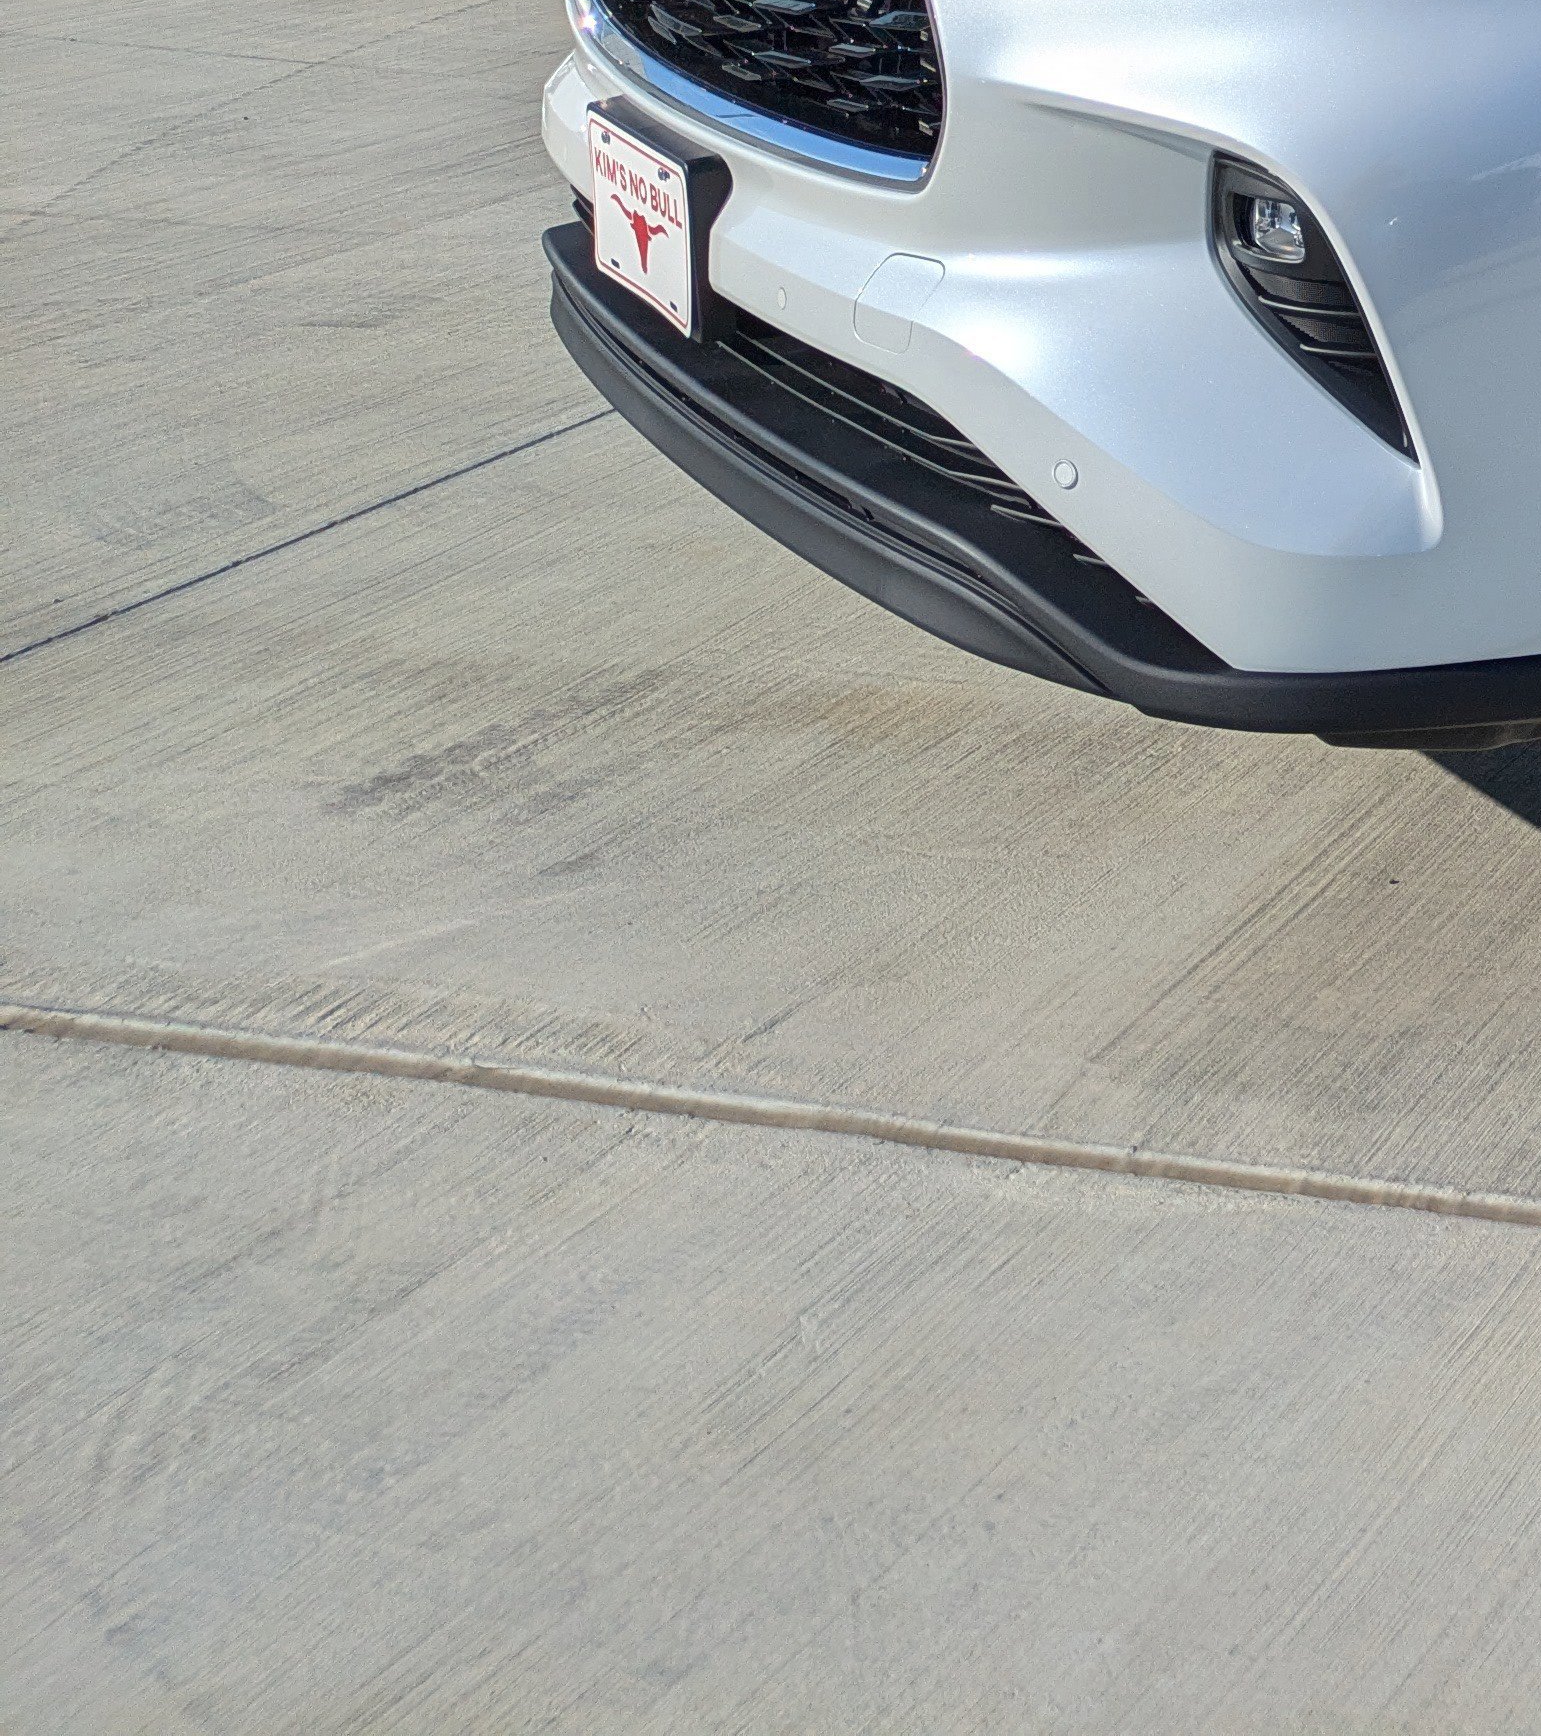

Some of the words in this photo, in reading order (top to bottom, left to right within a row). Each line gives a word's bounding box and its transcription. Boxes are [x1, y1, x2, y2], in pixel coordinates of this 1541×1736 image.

[594, 146, 627, 192] KIM'S
[629, 170, 647, 204] NO
[649, 182, 682, 229] BULL
